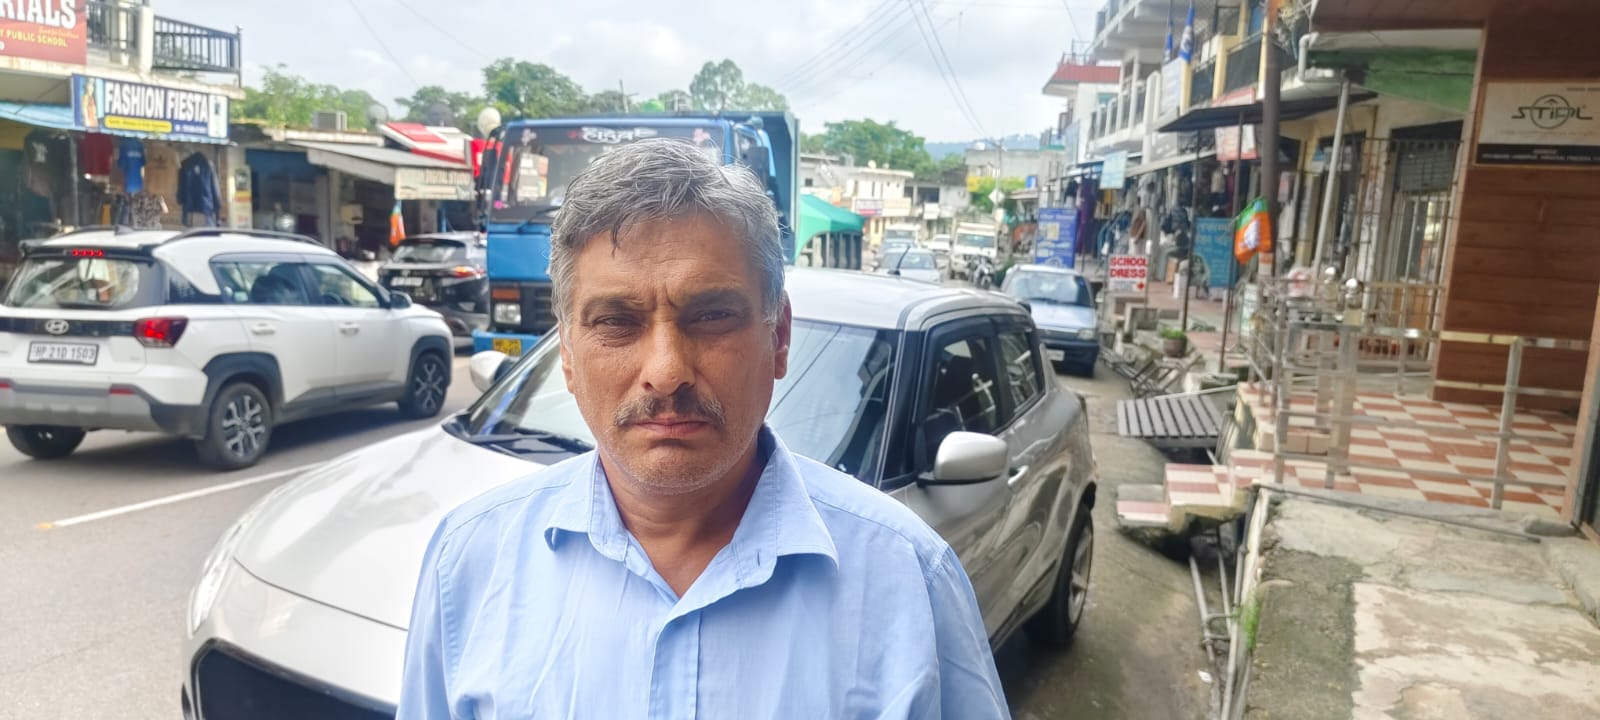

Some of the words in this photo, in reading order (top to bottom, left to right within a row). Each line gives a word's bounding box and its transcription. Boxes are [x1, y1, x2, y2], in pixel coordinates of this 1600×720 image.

[6, 28, 35, 42] PUBLIC
[37, 34, 68, 48] SCHOOL
[104, 81, 165, 119] FASHION
[166, 89, 208, 122] FIESTA
[1110, 256, 1146, 267] SCHOOL
[1110, 268, 1146, 279] DRESS
[36, 345, 47, 357] HP
[71, 347, 95, 360] 1503
